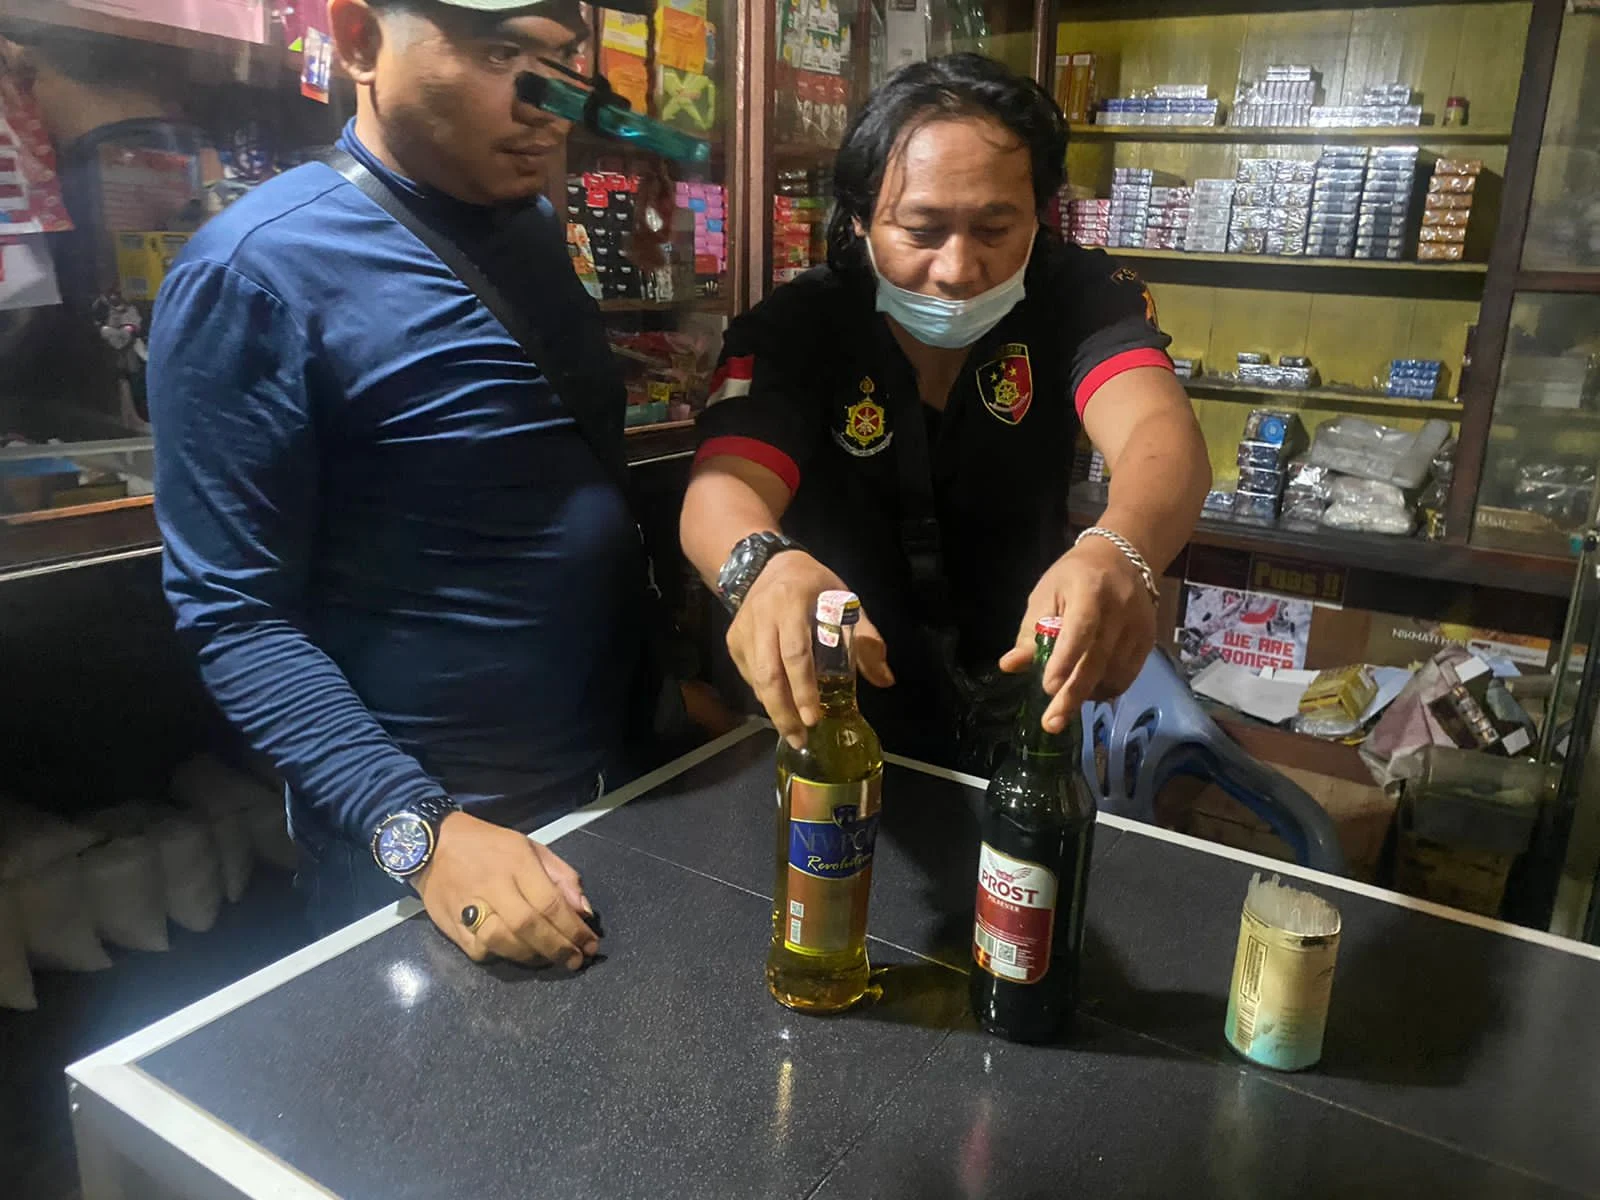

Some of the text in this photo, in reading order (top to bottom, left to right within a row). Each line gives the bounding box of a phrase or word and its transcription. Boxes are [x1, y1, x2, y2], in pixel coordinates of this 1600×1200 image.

[1223, 631, 1295, 657] WE ARE
[982, 868, 1040, 905] PROST
